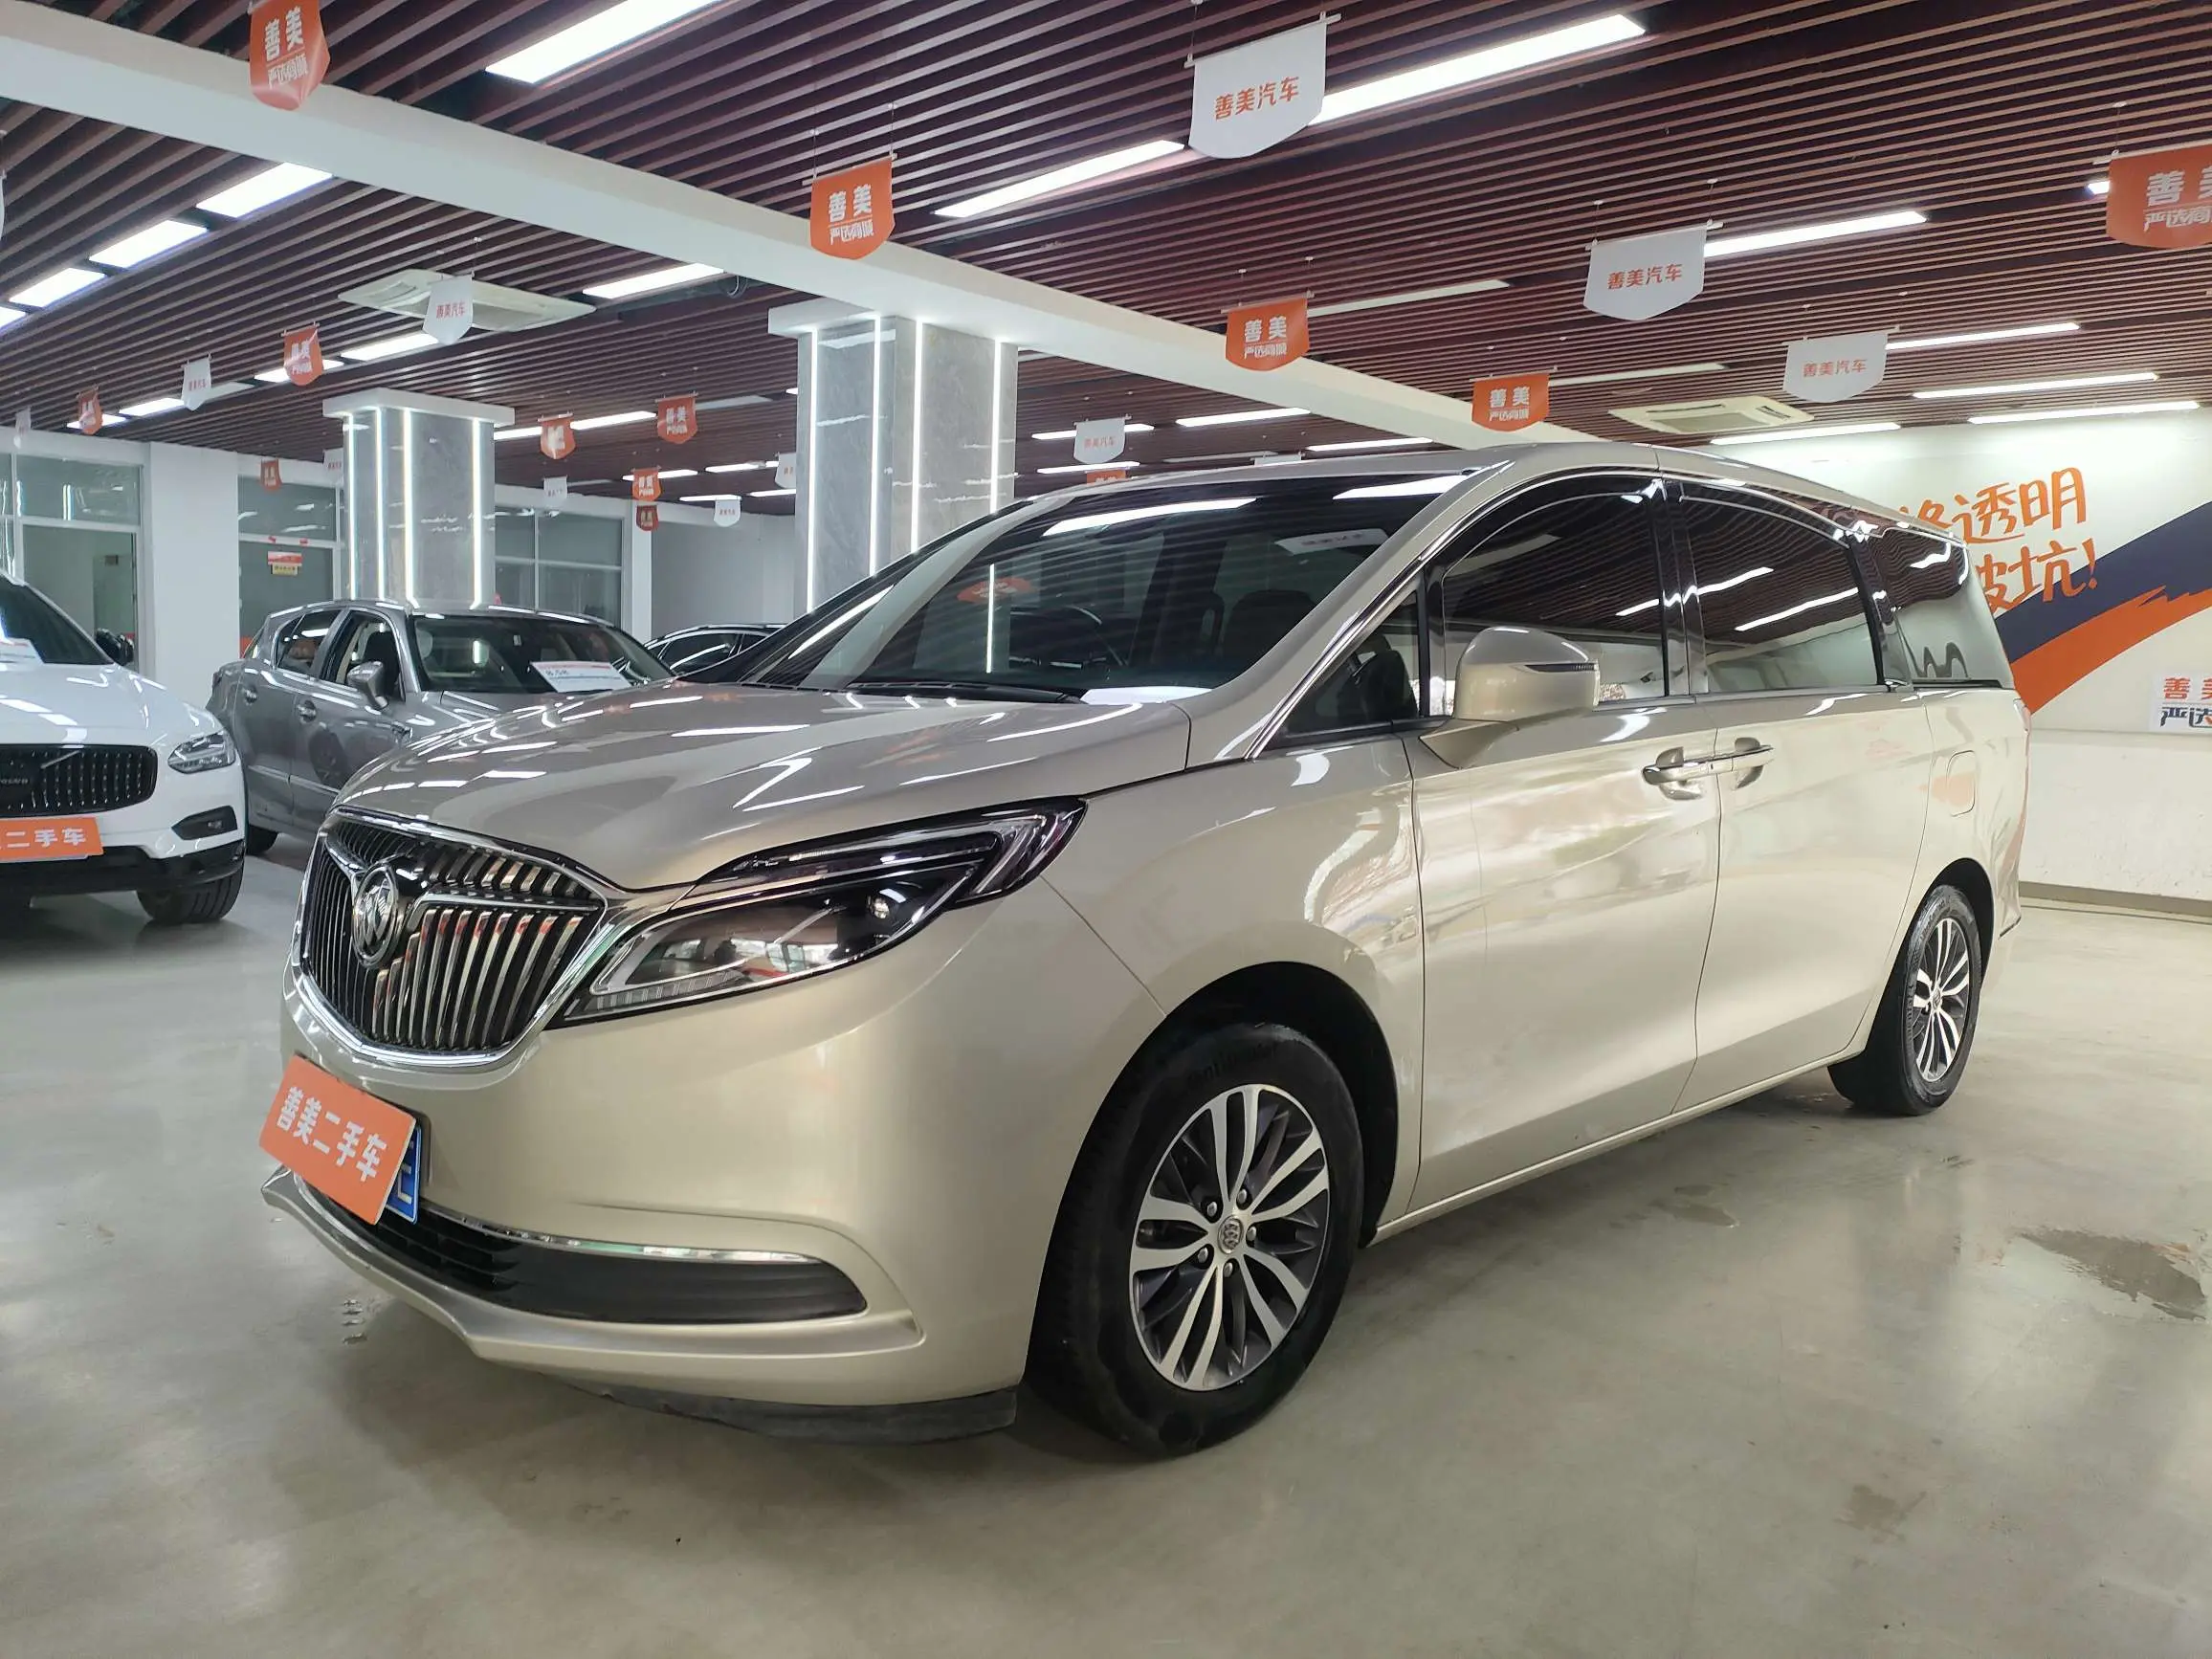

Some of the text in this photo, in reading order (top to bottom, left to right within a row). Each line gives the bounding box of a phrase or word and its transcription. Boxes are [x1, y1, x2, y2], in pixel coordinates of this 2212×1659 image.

[265, 6, 303, 61] 善美
[1215, 77, 1299, 121] 善美汽车
[829, 184, 872, 222] 善美
[1607, 263, 1683, 290] 善美汽车
[1245, 315, 1287, 343] 善美
[1803, 359, 1869, 377] 善美汽车
[1490, 386, 1530, 409] 善美
[0, 828, 87, 850] 二手车
[276, 1086, 387, 1183] 善美二手车
